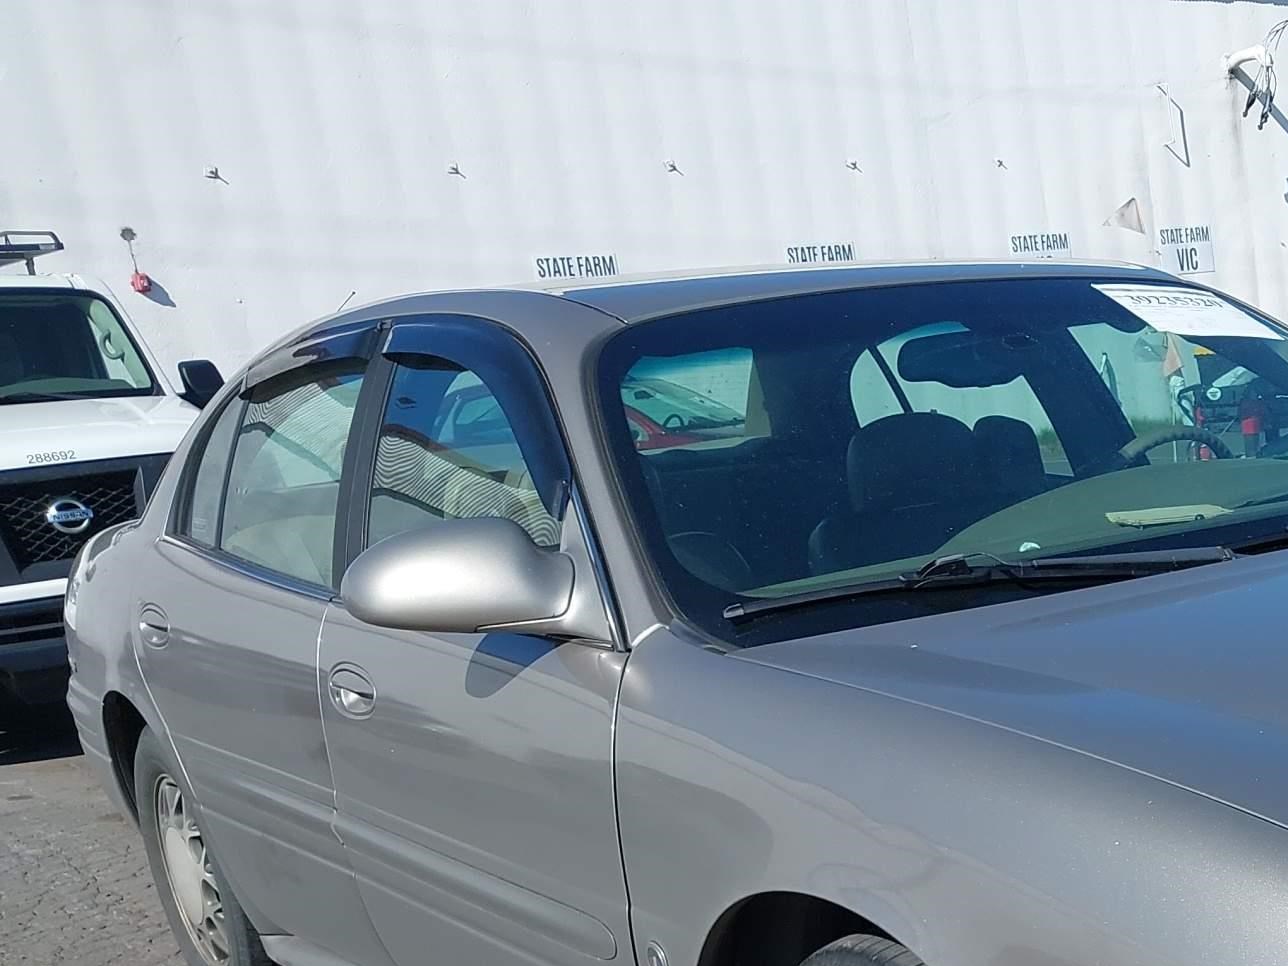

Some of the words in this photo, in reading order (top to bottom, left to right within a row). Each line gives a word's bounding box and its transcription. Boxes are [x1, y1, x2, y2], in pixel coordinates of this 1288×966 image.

[1011, 235, 1040, 253] STATE
[1040, 233, 1069, 251] FARM
[1160, 228, 1184, 245] STATE
[1185, 225, 1210, 243] FARM
[786, 246, 817, 264] STATE
[820, 243, 854, 262] FARM
[1176, 247, 1199, 272] VIC
[536, 256, 575, 278] STATE
[576, 255, 616, 277] FARM
[26, 449, 77, 464] 288692
[52, 510, 90, 521] NISSAN
